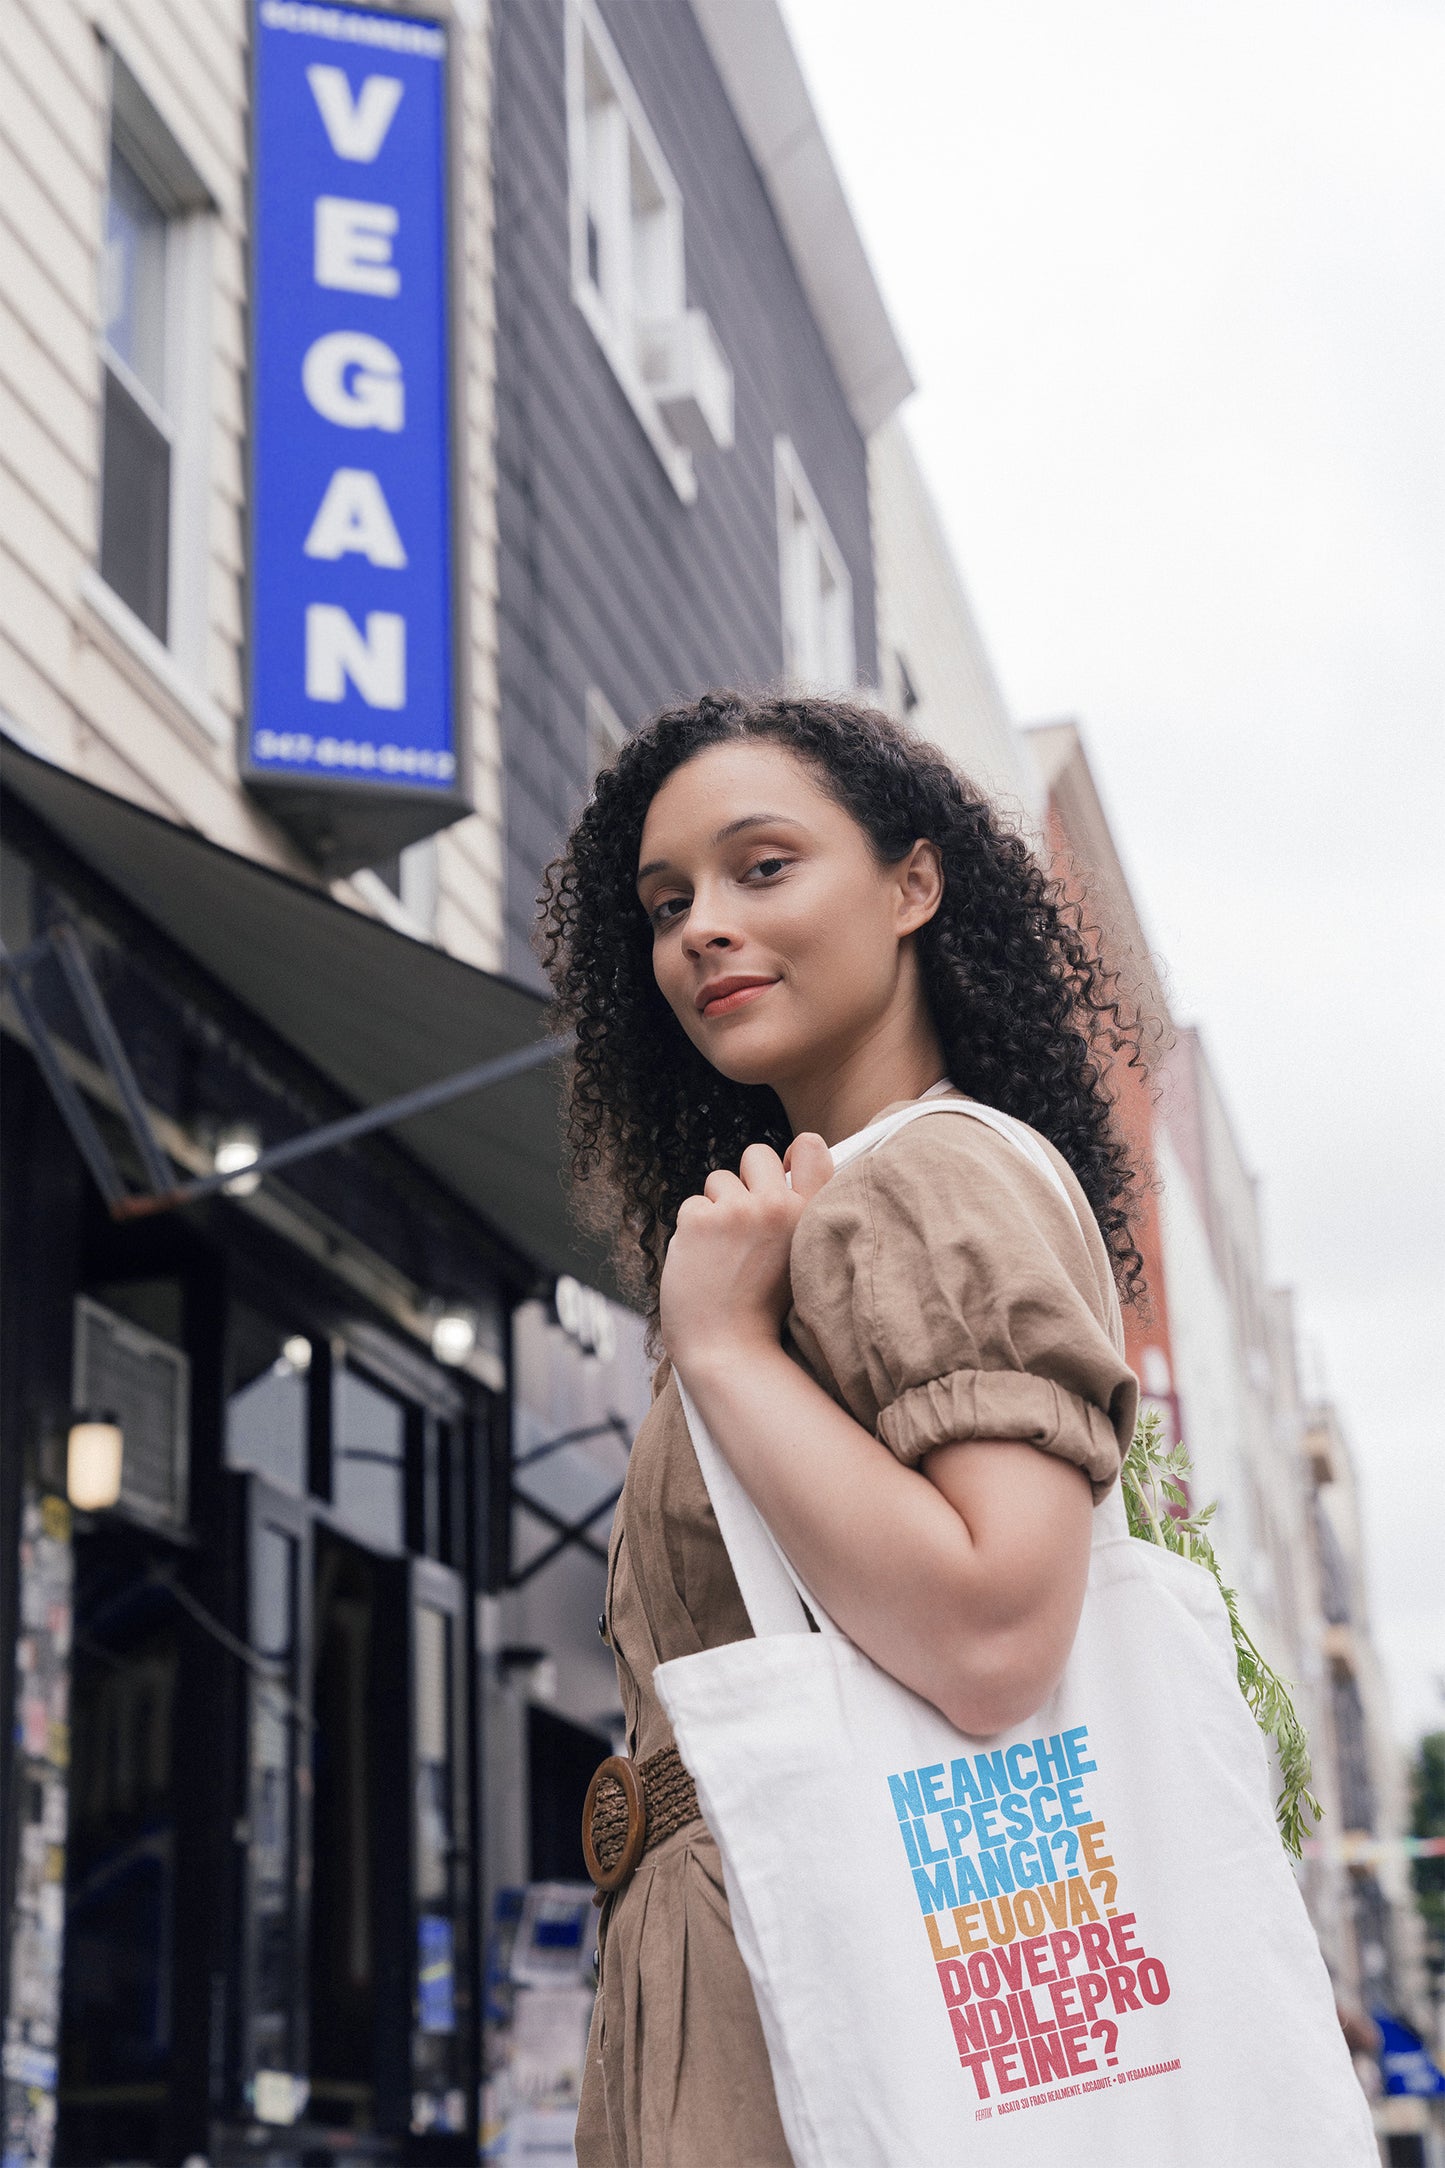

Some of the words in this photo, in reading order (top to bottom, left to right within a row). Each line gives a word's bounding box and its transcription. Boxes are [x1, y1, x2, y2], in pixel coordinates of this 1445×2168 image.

[303, 63, 407, 711] VEGAN
[887, 1725, 1098, 1822] NEANCHE
[899, 1776, 1093, 1869] ILPESCE
[923, 1869, 1118, 1962] LEUOVA?
[935, 1912, 1146, 2009] DOVEPRE
[948, 1957, 1171, 2056] NDILEPRO
[959, 2019, 1119, 2100] TEINE?
[997, 2102, 1021, 2116] BASATO
[1021, 2098, 1030, 2109] SU
[1029, 2093, 1048, 2108] FRASI
[1047, 2086, 1082, 2103] REALMENTE
[1117, 2074, 1127, 2085] GO
